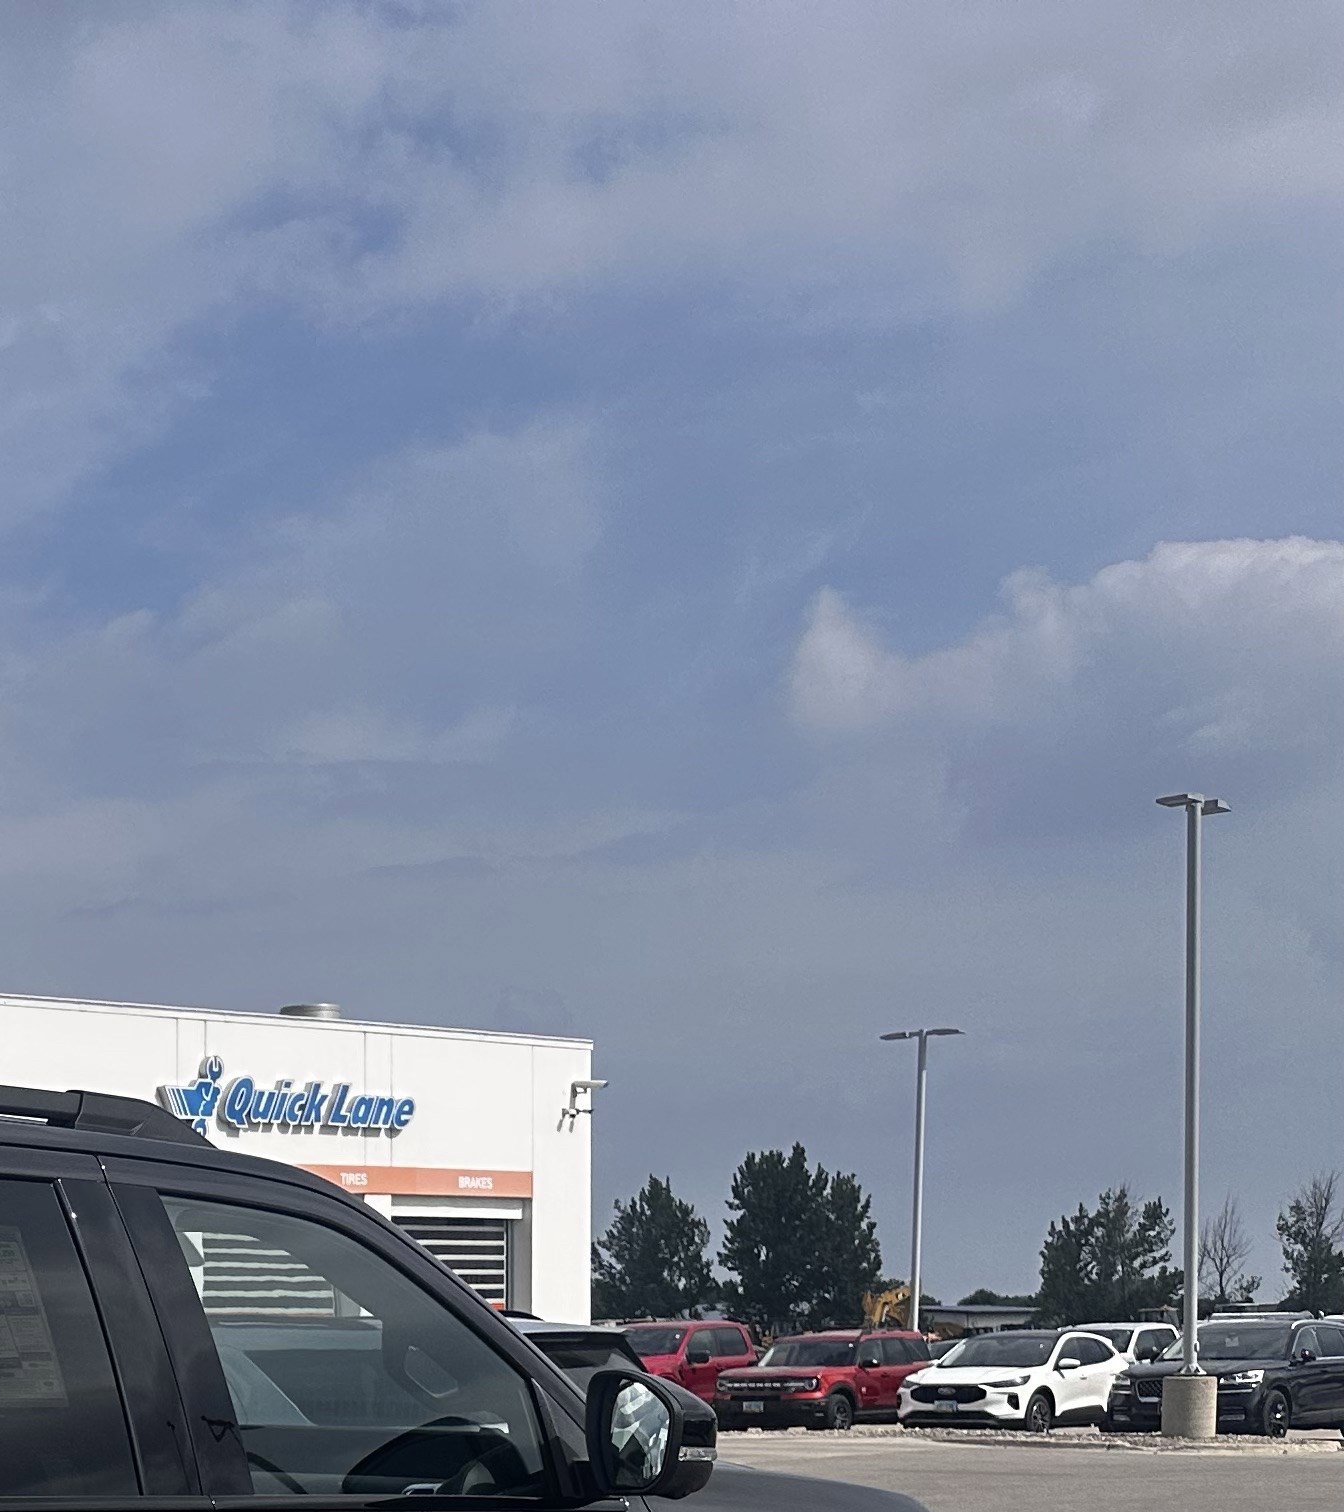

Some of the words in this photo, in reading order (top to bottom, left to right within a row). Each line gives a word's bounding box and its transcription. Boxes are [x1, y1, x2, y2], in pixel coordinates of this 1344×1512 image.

[224, 1075, 331, 1130] Quick
[327, 1081, 416, 1130] Lane
[340, 1172, 368, 1186] TIRES
[458, 1176, 493, 1190] BRAKES
